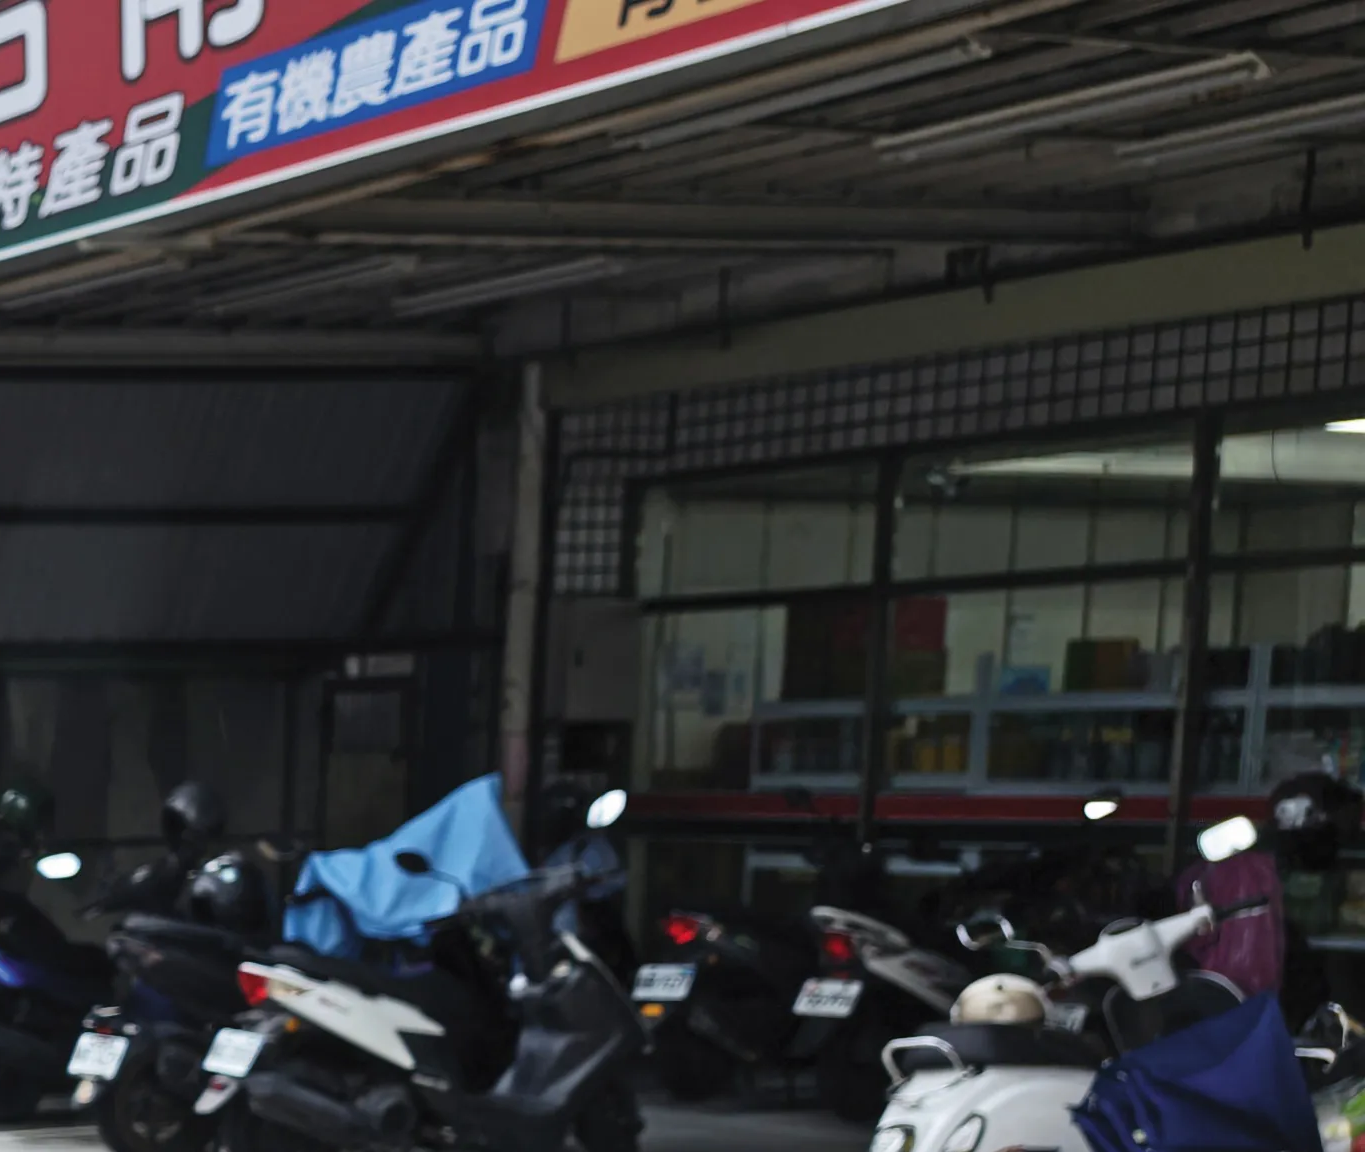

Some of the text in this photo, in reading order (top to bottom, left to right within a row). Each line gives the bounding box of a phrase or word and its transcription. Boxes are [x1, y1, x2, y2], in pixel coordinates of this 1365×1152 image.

[220, 0, 528, 151] 有機農產品
